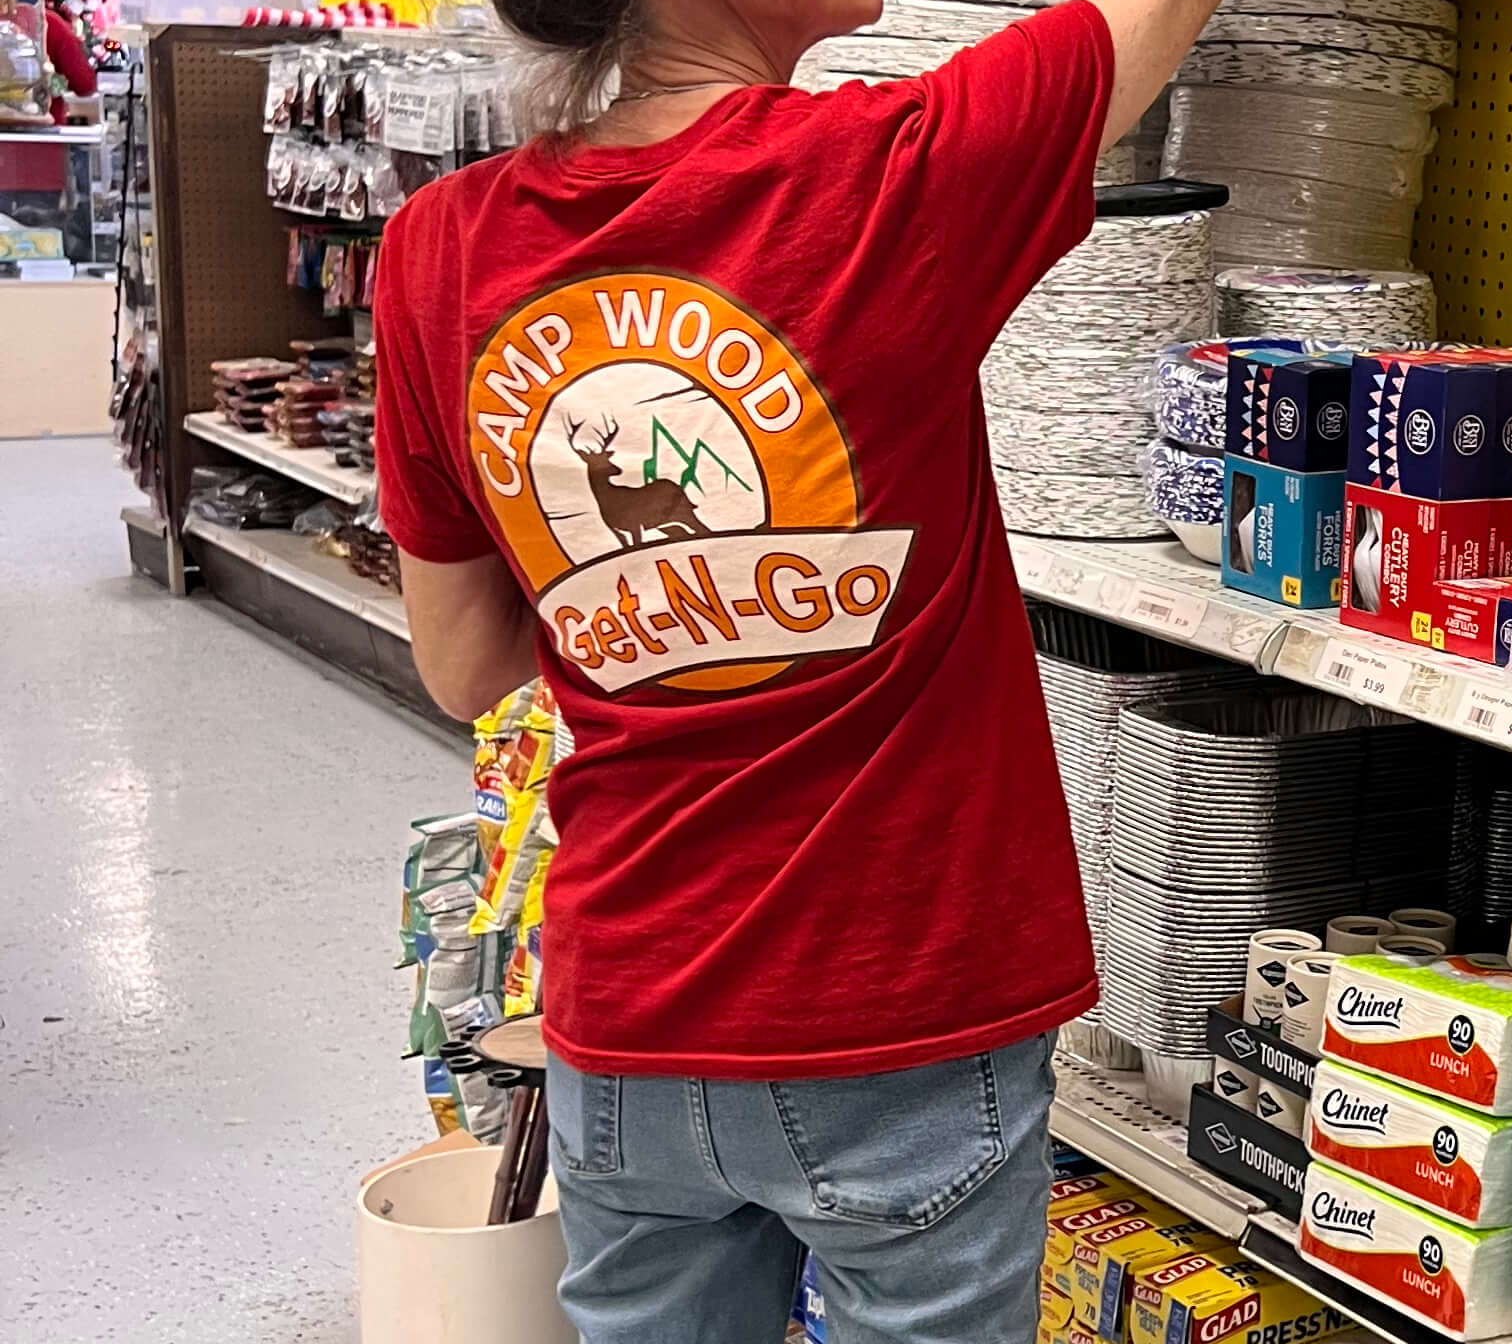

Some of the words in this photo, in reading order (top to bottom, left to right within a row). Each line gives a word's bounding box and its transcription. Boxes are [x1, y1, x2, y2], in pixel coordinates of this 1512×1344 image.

[478, 313, 574, 498] CAMP
[593, 288, 804, 433] WOOD
[1257, 506, 1267, 561] FORKS
[1322, 515, 1334, 567] FORKS
[1383, 543, 1391, 585] COMBO
[1389, 527, 1402, 608] CUTLERY
[553, 552, 891, 670] Get-N-Go
[1337, 987, 1403, 1019] Chinet
[1452, 1020, 1471, 1040] 90
[1430, 1052, 1470, 1077] LUNCH
[1322, 1089, 1388, 1124] Chinet
[1437, 1133, 1456, 1151] 90
[1415, 1161, 1454, 1189] LUNCH
[1311, 1191, 1376, 1231] Chinet
[1402, 1268, 1441, 1299] LUNCH
[1200, 1300, 1258, 1342] GLAD
